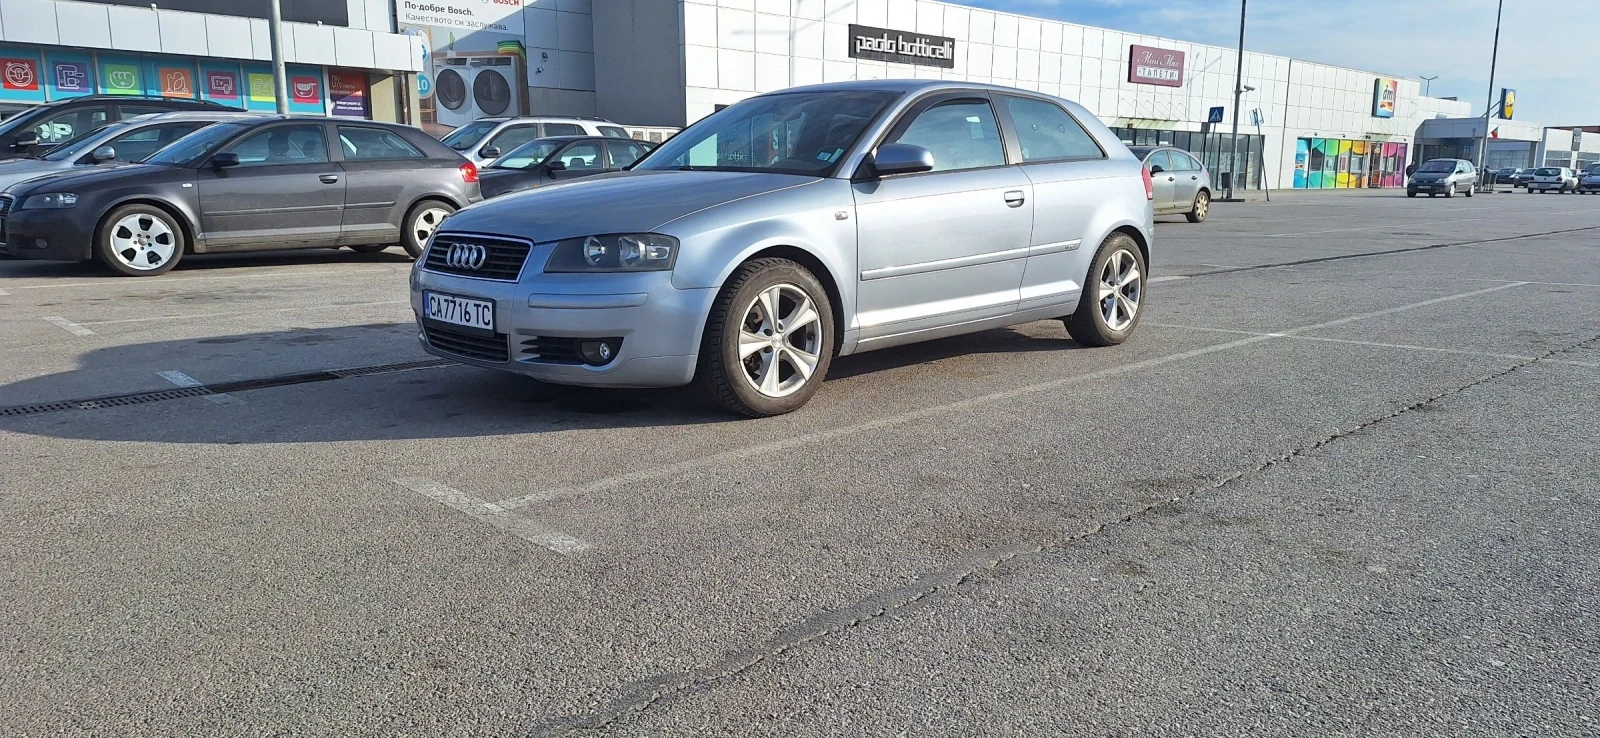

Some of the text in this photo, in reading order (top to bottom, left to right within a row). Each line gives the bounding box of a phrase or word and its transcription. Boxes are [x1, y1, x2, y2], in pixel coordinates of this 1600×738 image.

[404, 1, 475, 16] По-добре Bosch.
[405, 12, 452, 25] Качеството
[467, 21, 509, 31] заслужава.
[856, 33, 953, 60] paolo botticelli
[1137, 50, 1159, 65] Mini
[1382, 84, 1394, 101] dm
